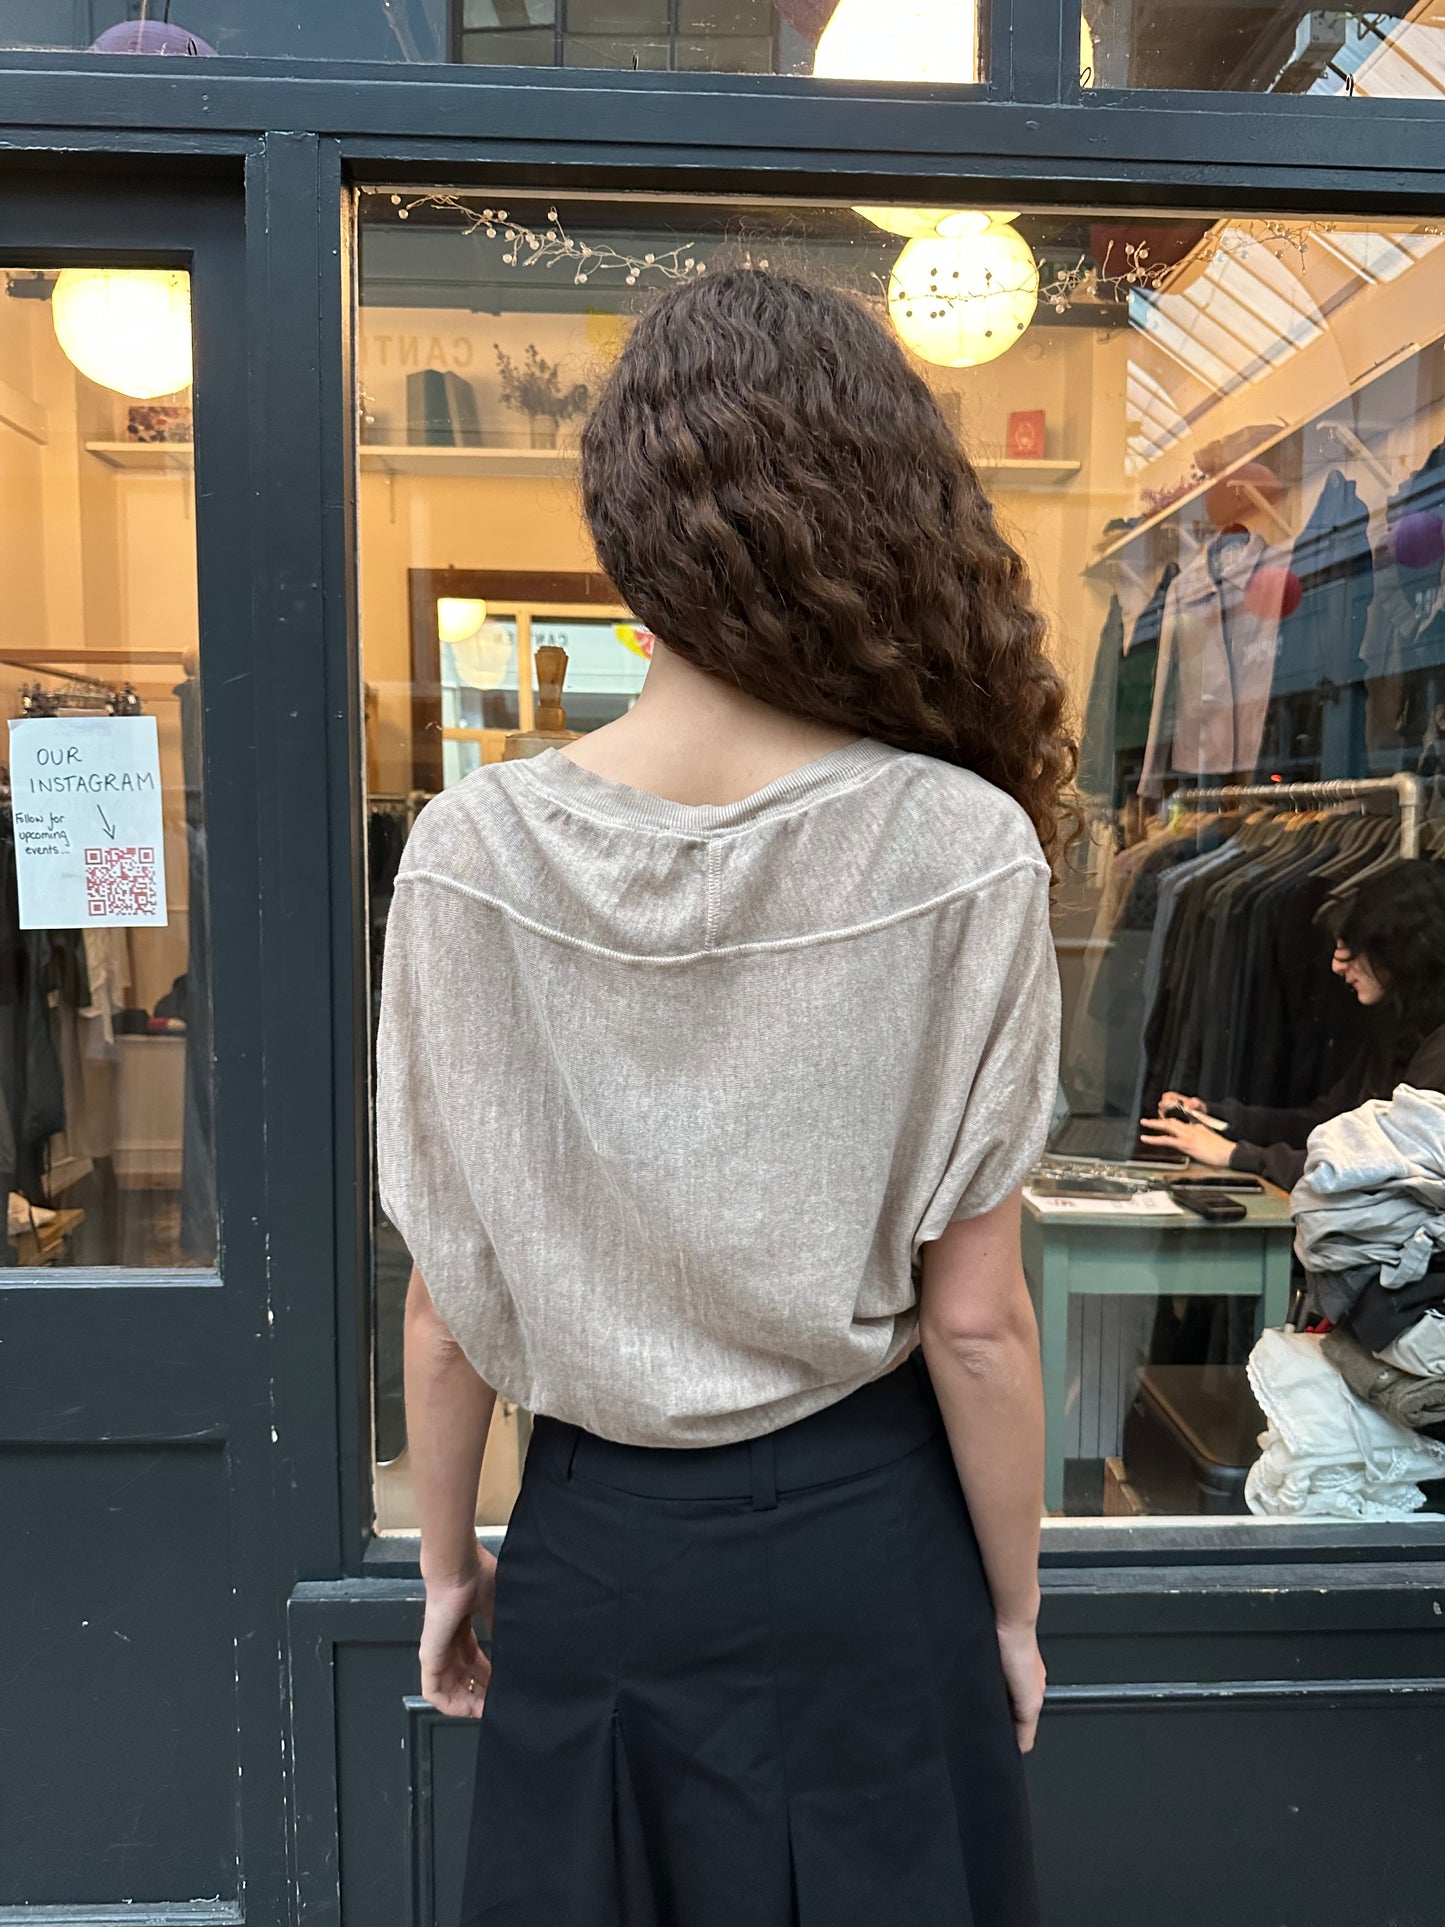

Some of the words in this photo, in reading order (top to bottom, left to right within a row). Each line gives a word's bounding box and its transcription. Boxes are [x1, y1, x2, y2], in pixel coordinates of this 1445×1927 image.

[37, 746, 82, 766] OUR
[30, 772, 155, 793] INSTAGRAM
[15, 812, 44, 824] Follow
[48, 812, 65, 831] for
[19, 830, 70, 847] upcoming
